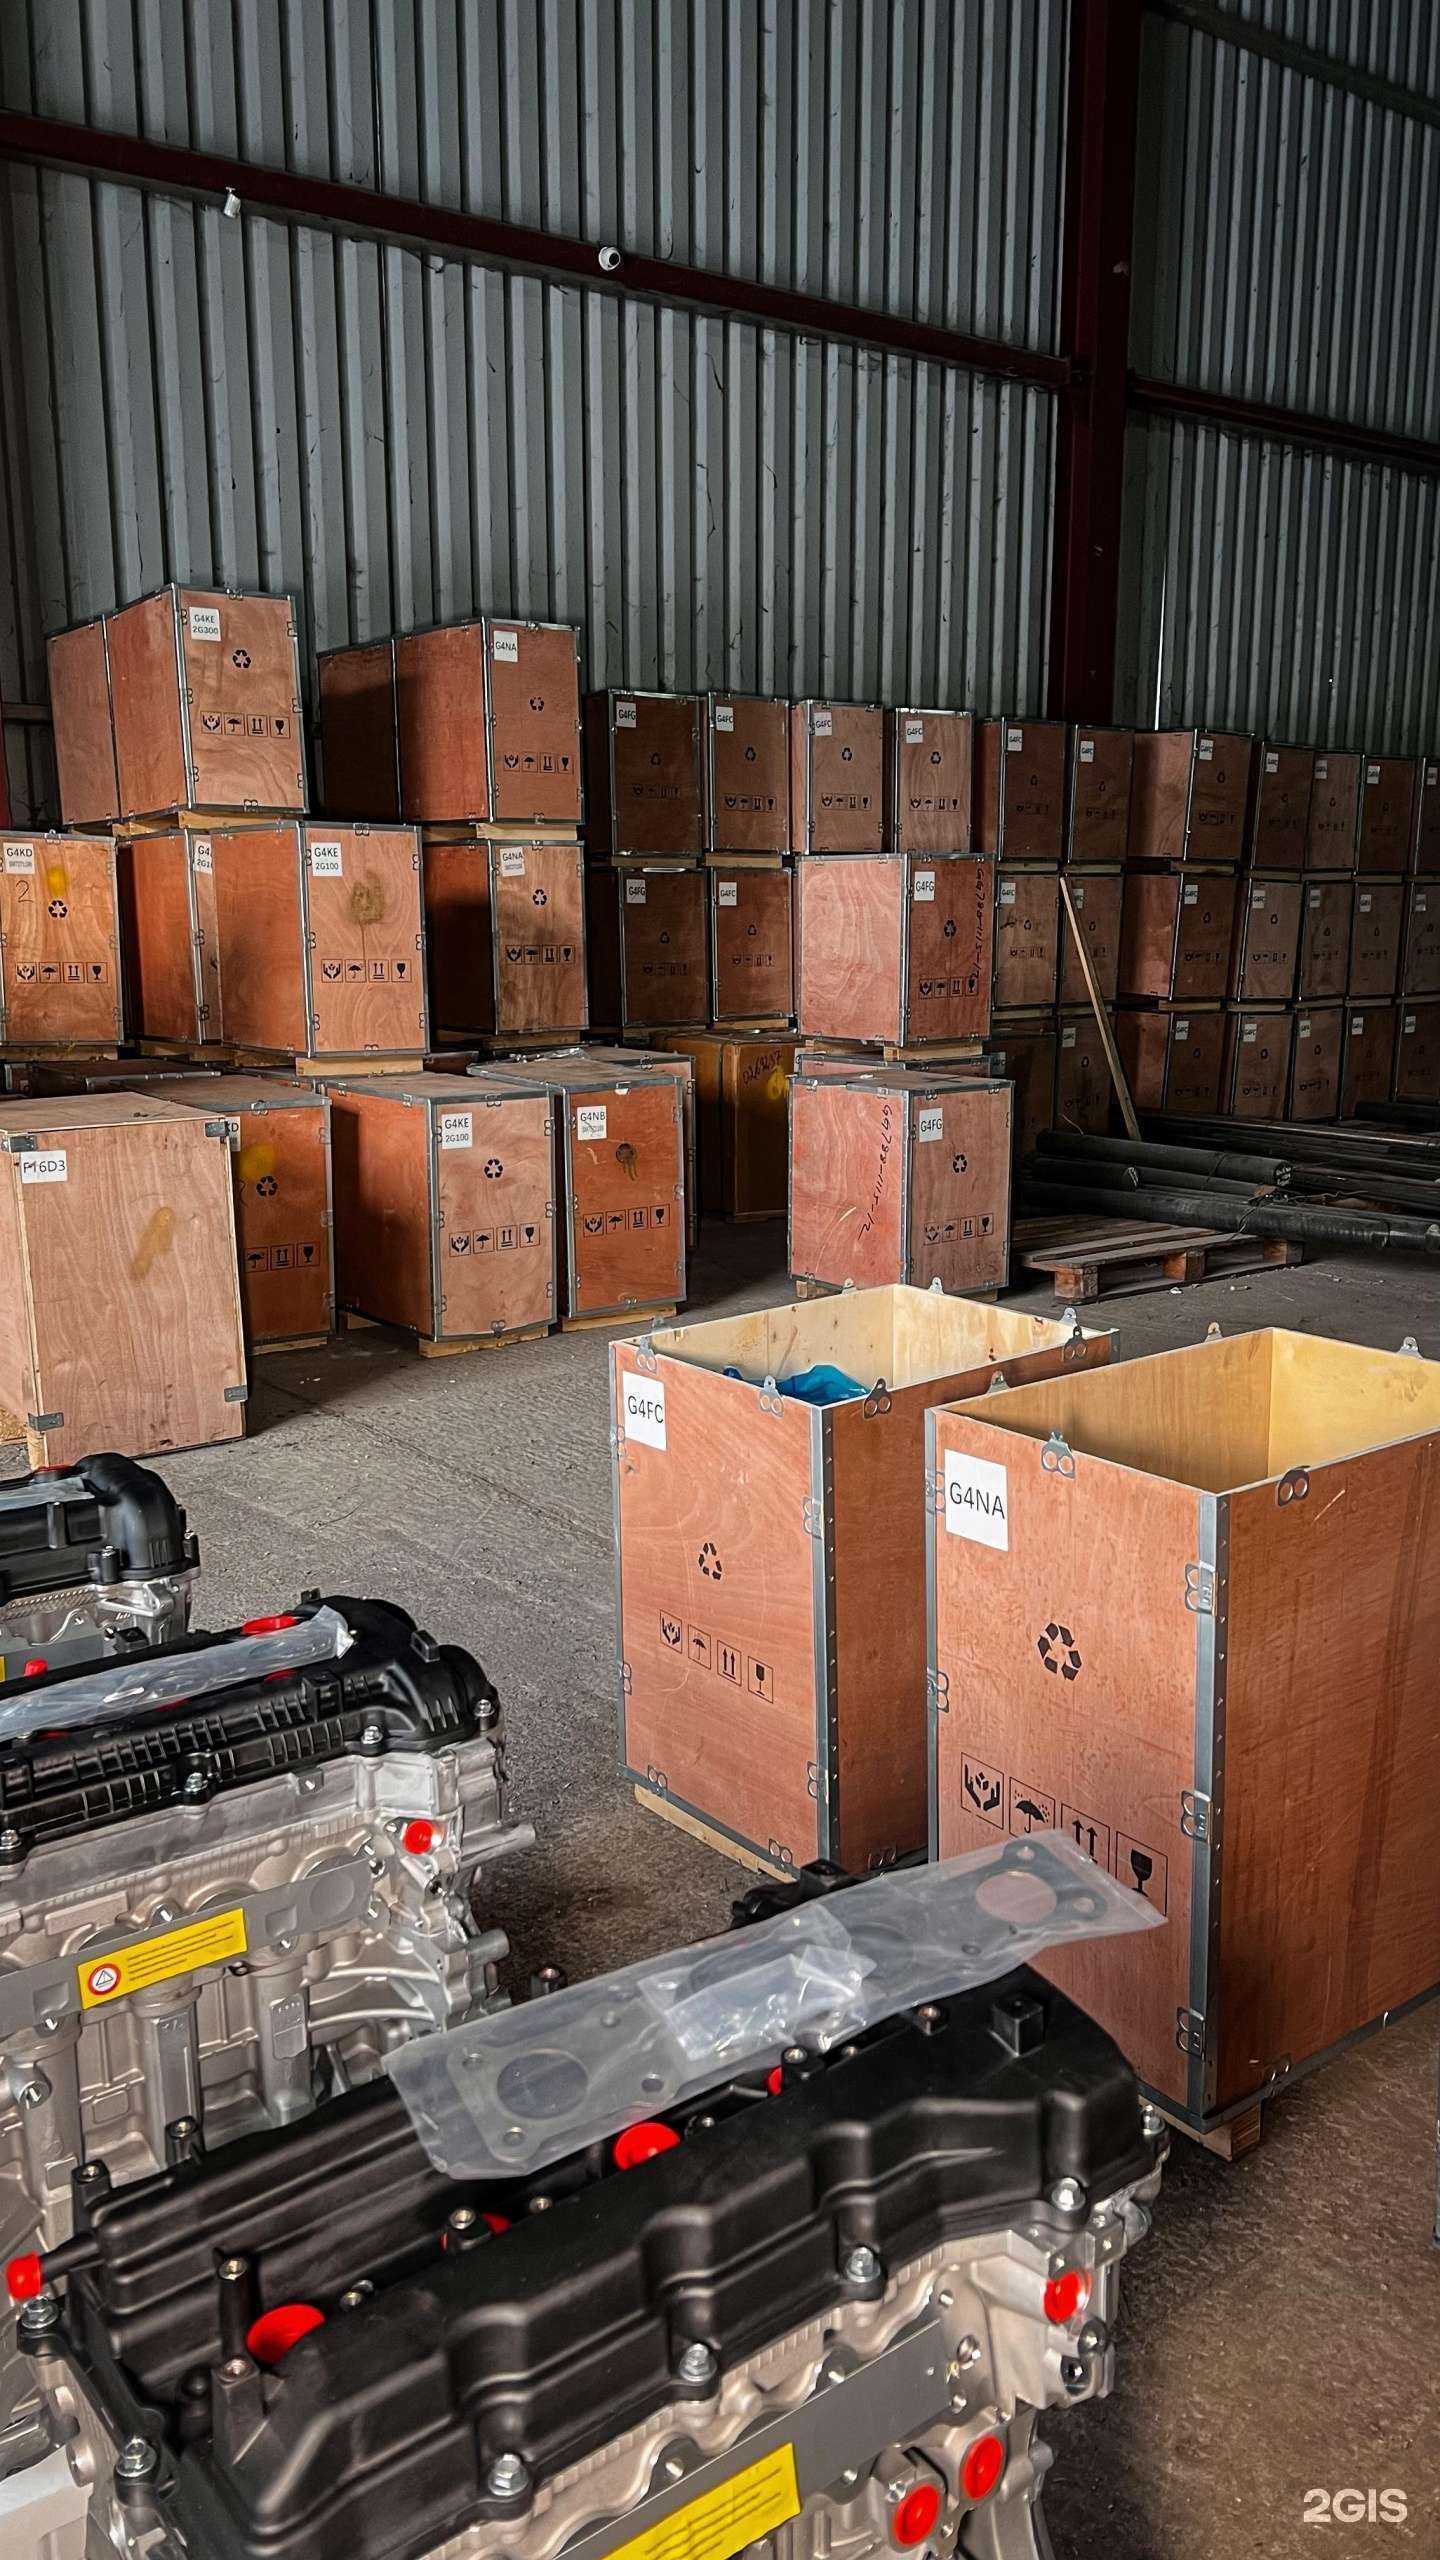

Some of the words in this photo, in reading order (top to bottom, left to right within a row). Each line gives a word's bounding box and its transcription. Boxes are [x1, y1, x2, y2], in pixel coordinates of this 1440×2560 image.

[194, 613, 215, 624] G4KE
[495, 641, 517, 652] G4NA
[7, 847, 33, 857] G4KD
[314, 847, 339, 858] G4KE
[502, 851, 523, 863] G4NA
[315, 862, 339, 871] 2G100
[15, 880, 34, 903] 2
[916, 880, 935, 892] G4FG
[720, 889, 736, 897] G4FC
[580, 1111, 606, 1122] G4NB
[444, 1117, 470, 1130] G4KE
[920, 1118, 943, 1132] G4FG
[445, 1133, 470, 1143] 2G100
[628, 1395, 665, 1424] G4FC
[950, 1482, 1006, 1520] G4NA
